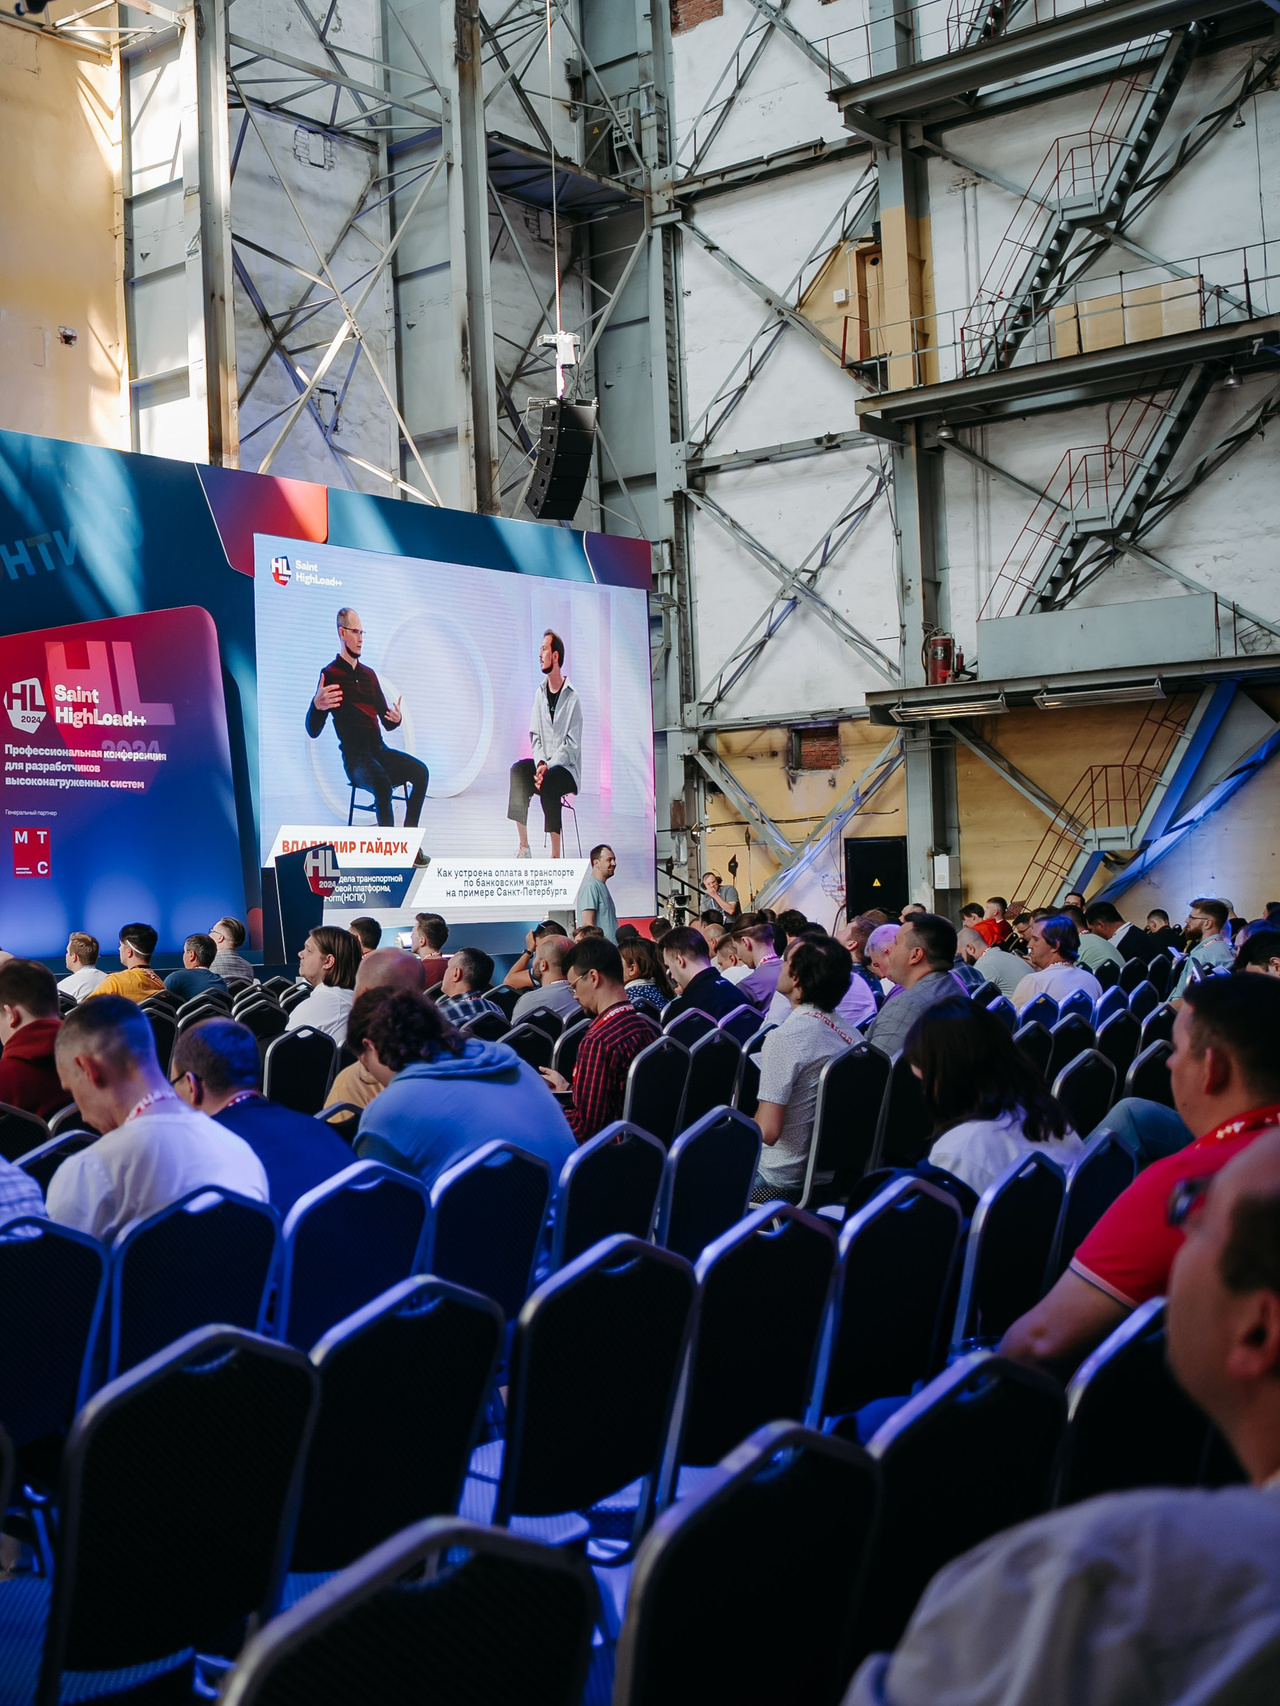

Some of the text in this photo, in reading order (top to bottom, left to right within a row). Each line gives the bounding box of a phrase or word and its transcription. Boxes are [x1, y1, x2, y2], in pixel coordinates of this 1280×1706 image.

[271, 558, 292, 575] HL
[295, 560, 318, 572] Saint
[295, 572, 343, 587] HighLoad++
[45, 641, 176, 725] HL
[7, 684, 47, 711] HL
[55, 684, 99, 703] Saint
[55, 706, 146, 728] HighLoad++
[5, 744, 167, 761] Профессиональная конференция
[5, 762, 100, 773] для разработчиков
[6, 777, 144, 789] высоконагруженных систем
[360, 838, 408, 856] ГАЙДУК
[306, 850, 341, 877] HL
[357, 875, 403, 884] транспортной
[437, 868, 453, 877] Как
[455, 869, 493, 879] устроена
[494, 869, 522, 877] оплата
[530, 869, 574, 880] транспорте
[353, 884, 391, 893] платформы,
[475, 878, 524, 887] банковским
[526, 879, 553, 888] картам
[446, 887, 567, 898] на примере Санкт-Петербурга
